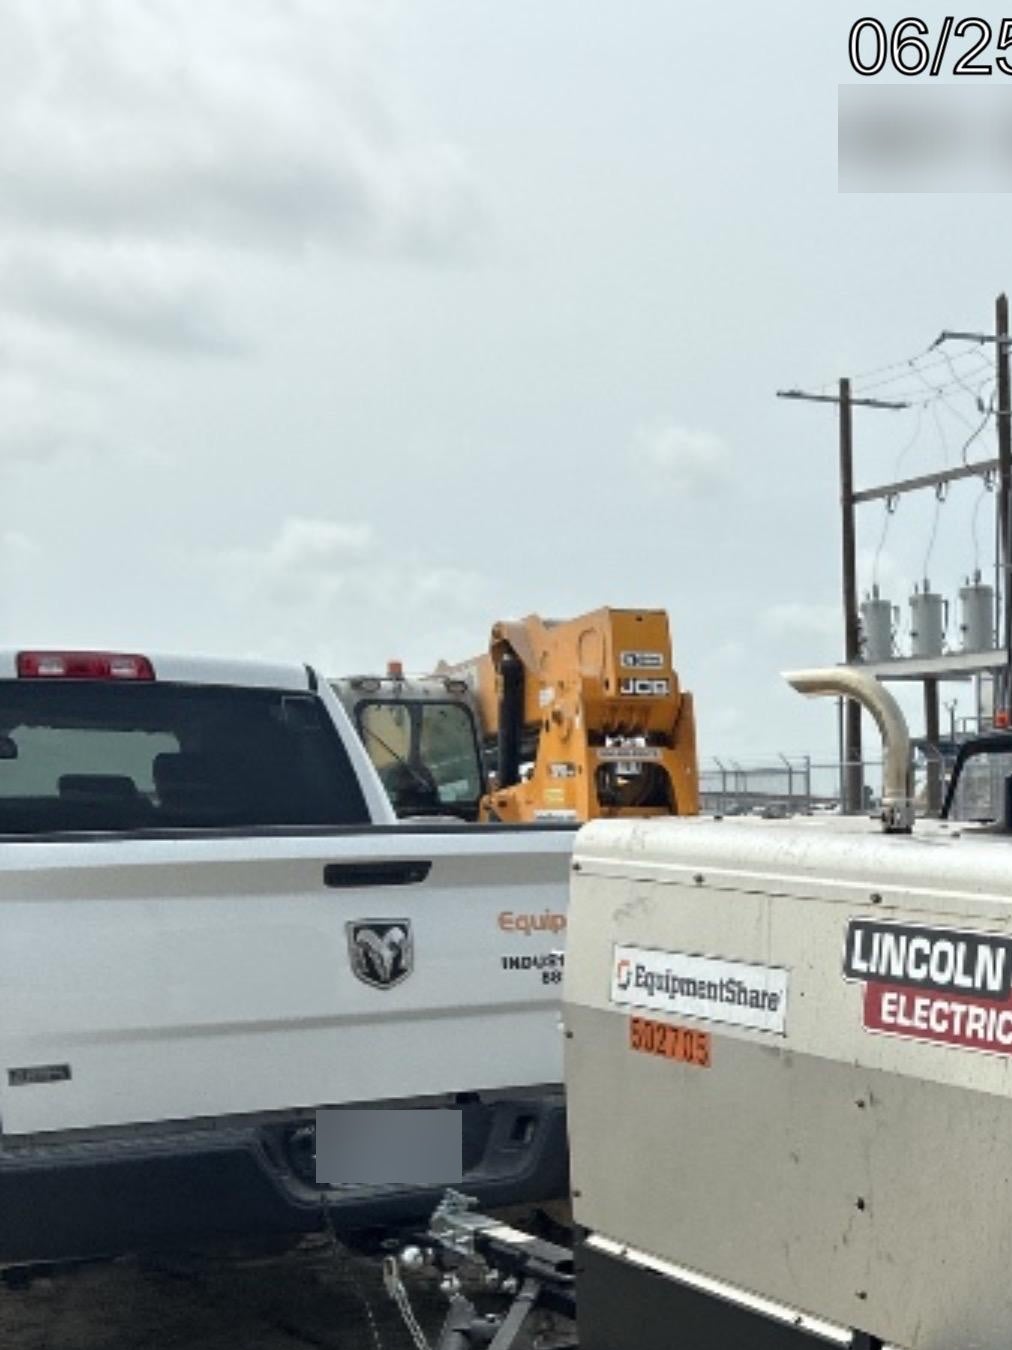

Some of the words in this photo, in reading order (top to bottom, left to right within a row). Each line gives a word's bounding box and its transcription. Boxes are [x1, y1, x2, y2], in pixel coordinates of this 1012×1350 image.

[498, 908, 567, 936] Equip
[851, 929, 1006, 992] LINCOLN
[634, 965, 779, 1012] EquipmentShare
[630, 1017, 711, 1066] 502705
